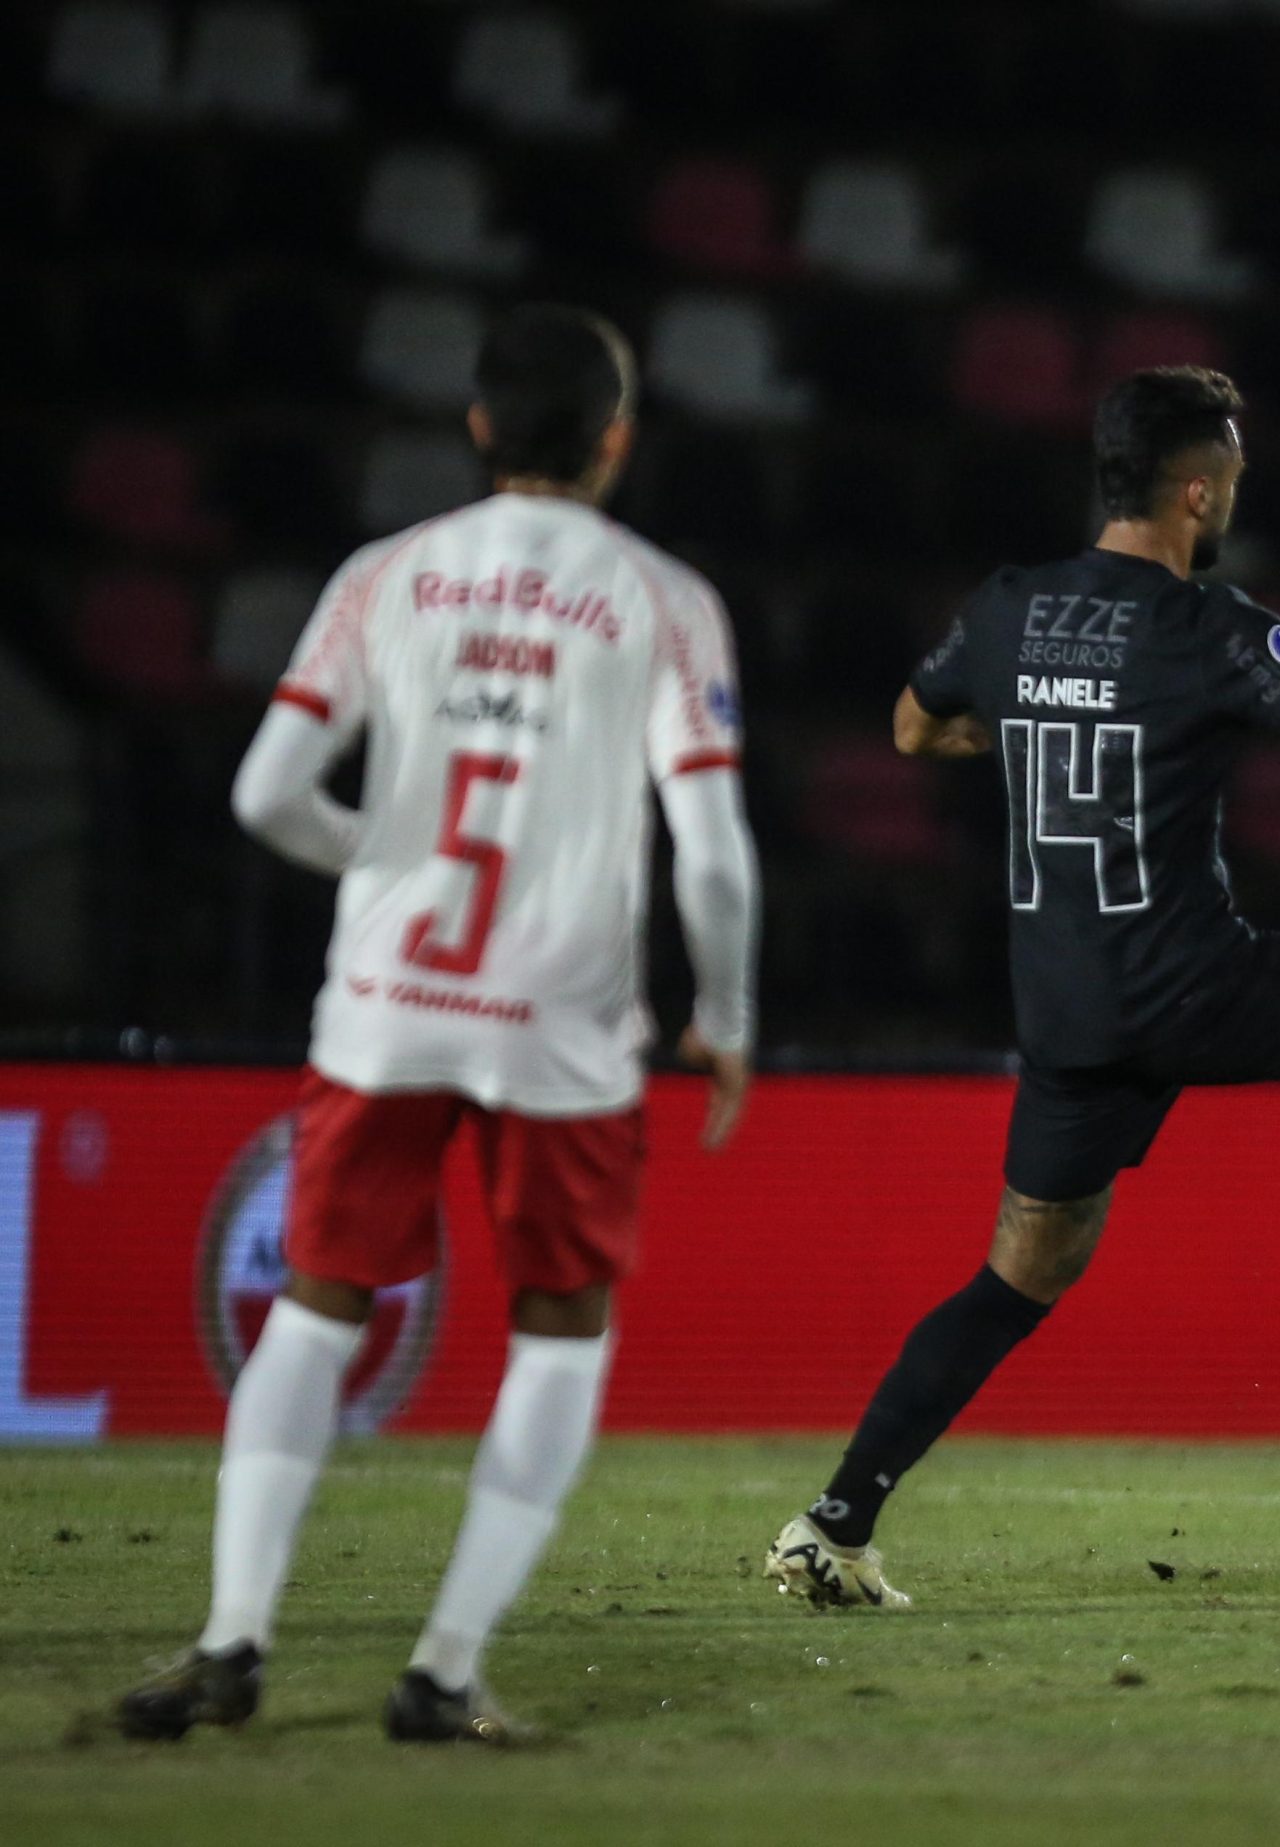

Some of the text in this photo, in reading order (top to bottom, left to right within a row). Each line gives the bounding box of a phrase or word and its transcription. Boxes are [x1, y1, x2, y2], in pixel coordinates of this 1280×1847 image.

[1023, 593, 1137, 643] EZZE
[1018, 641, 1124, 668] SEGUROS
[1017, 674, 1116, 709] RANIELE
[1000, 718, 1151, 914] 14
[403, 750, 520, 976] 5
